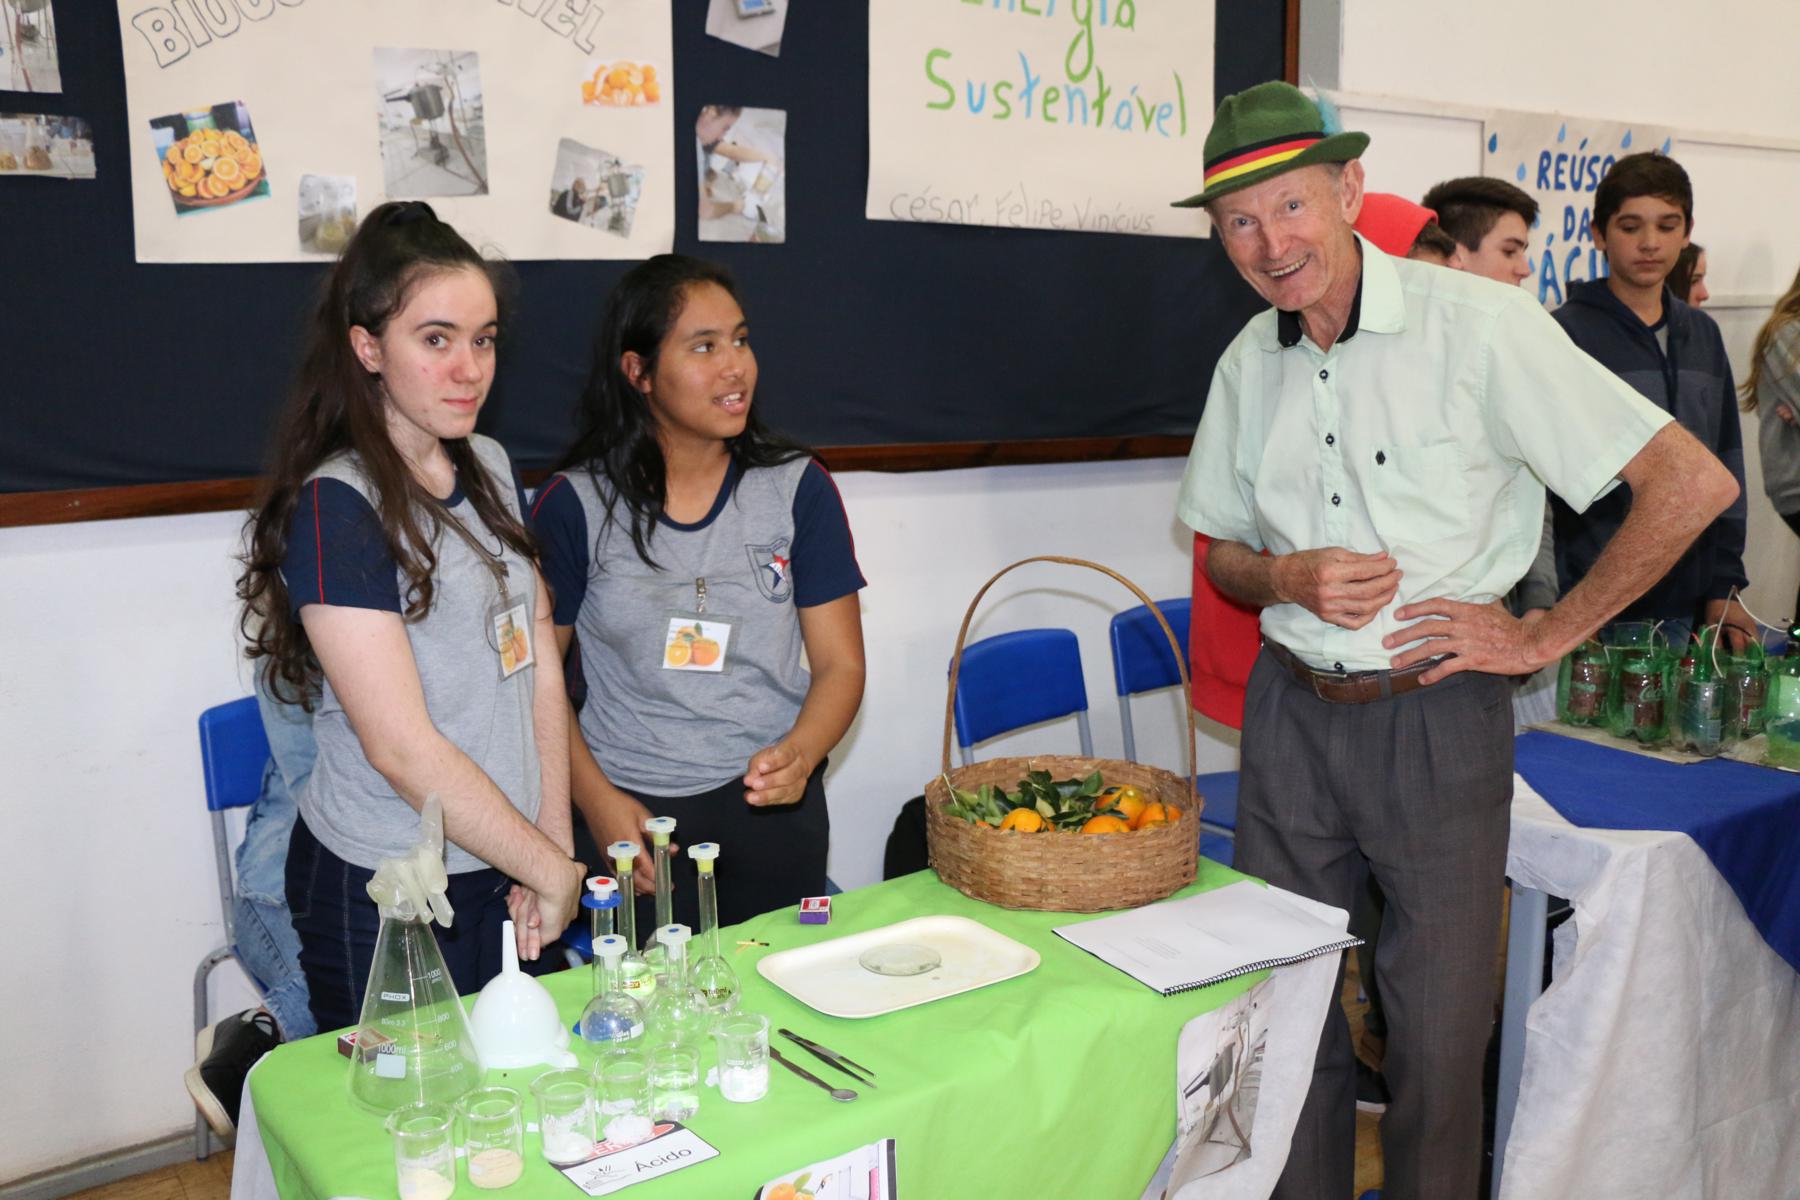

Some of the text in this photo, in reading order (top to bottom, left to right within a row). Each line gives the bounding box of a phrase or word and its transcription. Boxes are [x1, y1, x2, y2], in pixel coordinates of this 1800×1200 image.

[925, 47, 1187, 138] Sustentável
[1562, 205, 1594, 242] DA
[1538, 233, 1610, 305] ÁGU
[428, 968, 441, 980] 1000
[444, 1040, 457, 1052] 600
[634, 1148, 692, 1173] Ácido
